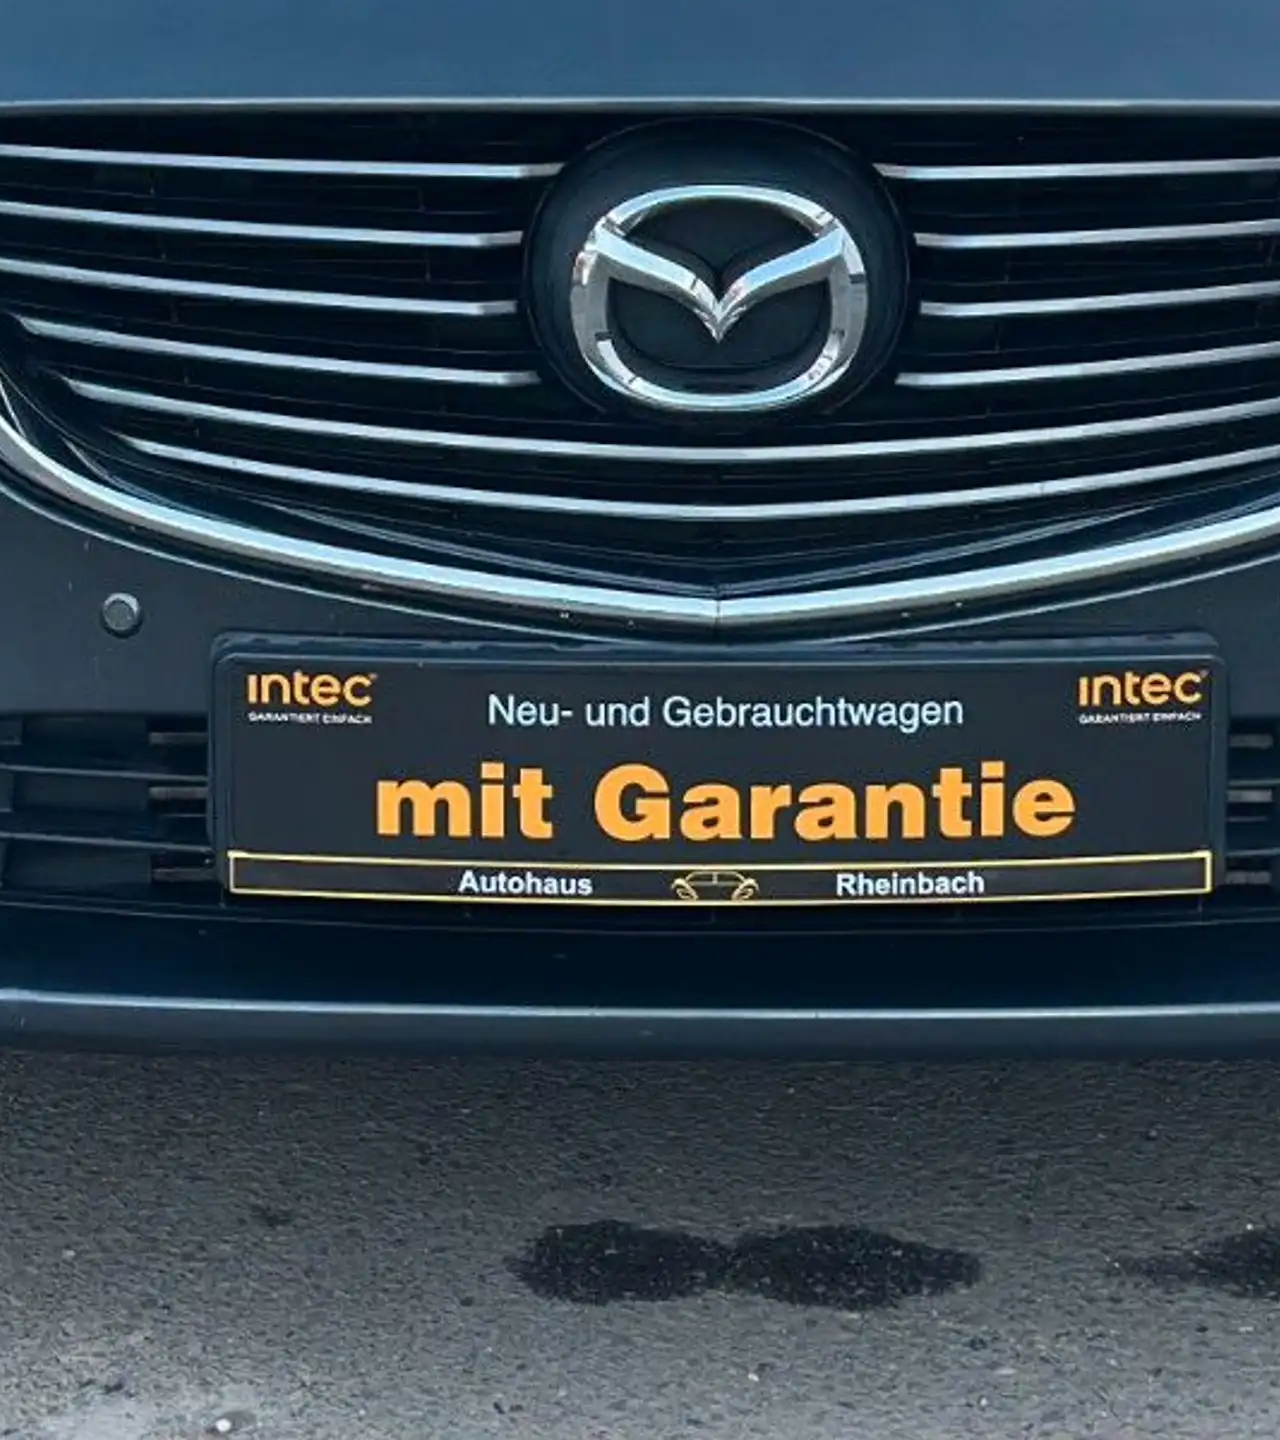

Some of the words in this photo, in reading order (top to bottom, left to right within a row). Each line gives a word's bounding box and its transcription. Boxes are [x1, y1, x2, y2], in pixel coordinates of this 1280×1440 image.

[488, 693, 573, 727] Neu-
[586, 696, 650, 728] und
[663, 695, 964, 734] Gebrauchtwagen
[376, 761, 554, 840] mit
[594, 760, 1076, 842] Garantie
[458, 868, 594, 897] Autohaus
[836, 870, 985, 898] Rheinbach
